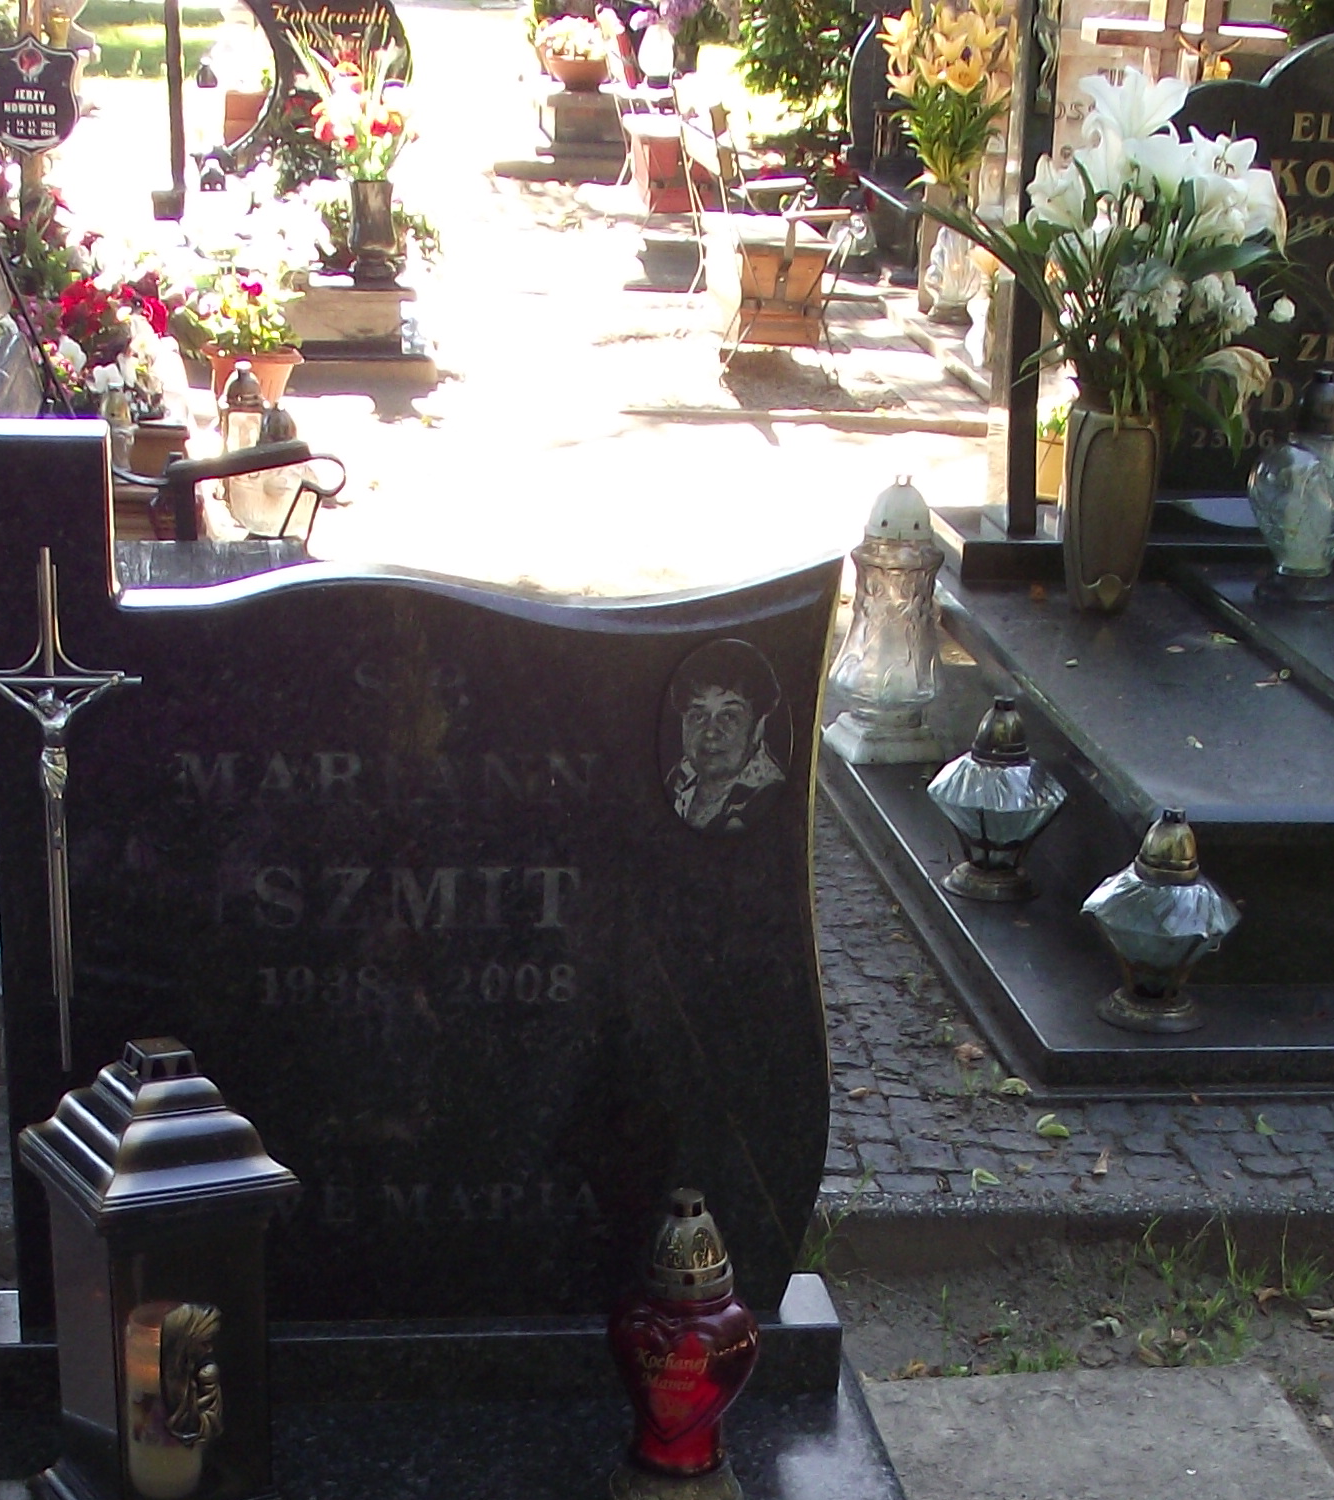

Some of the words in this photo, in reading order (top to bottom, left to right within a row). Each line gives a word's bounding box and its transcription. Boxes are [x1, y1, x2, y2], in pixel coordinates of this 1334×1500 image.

[14, 88, 46, 102] JERZY
[251, 864, 582, 932] SZMIT
[445, 961, 578, 1005] 2008
